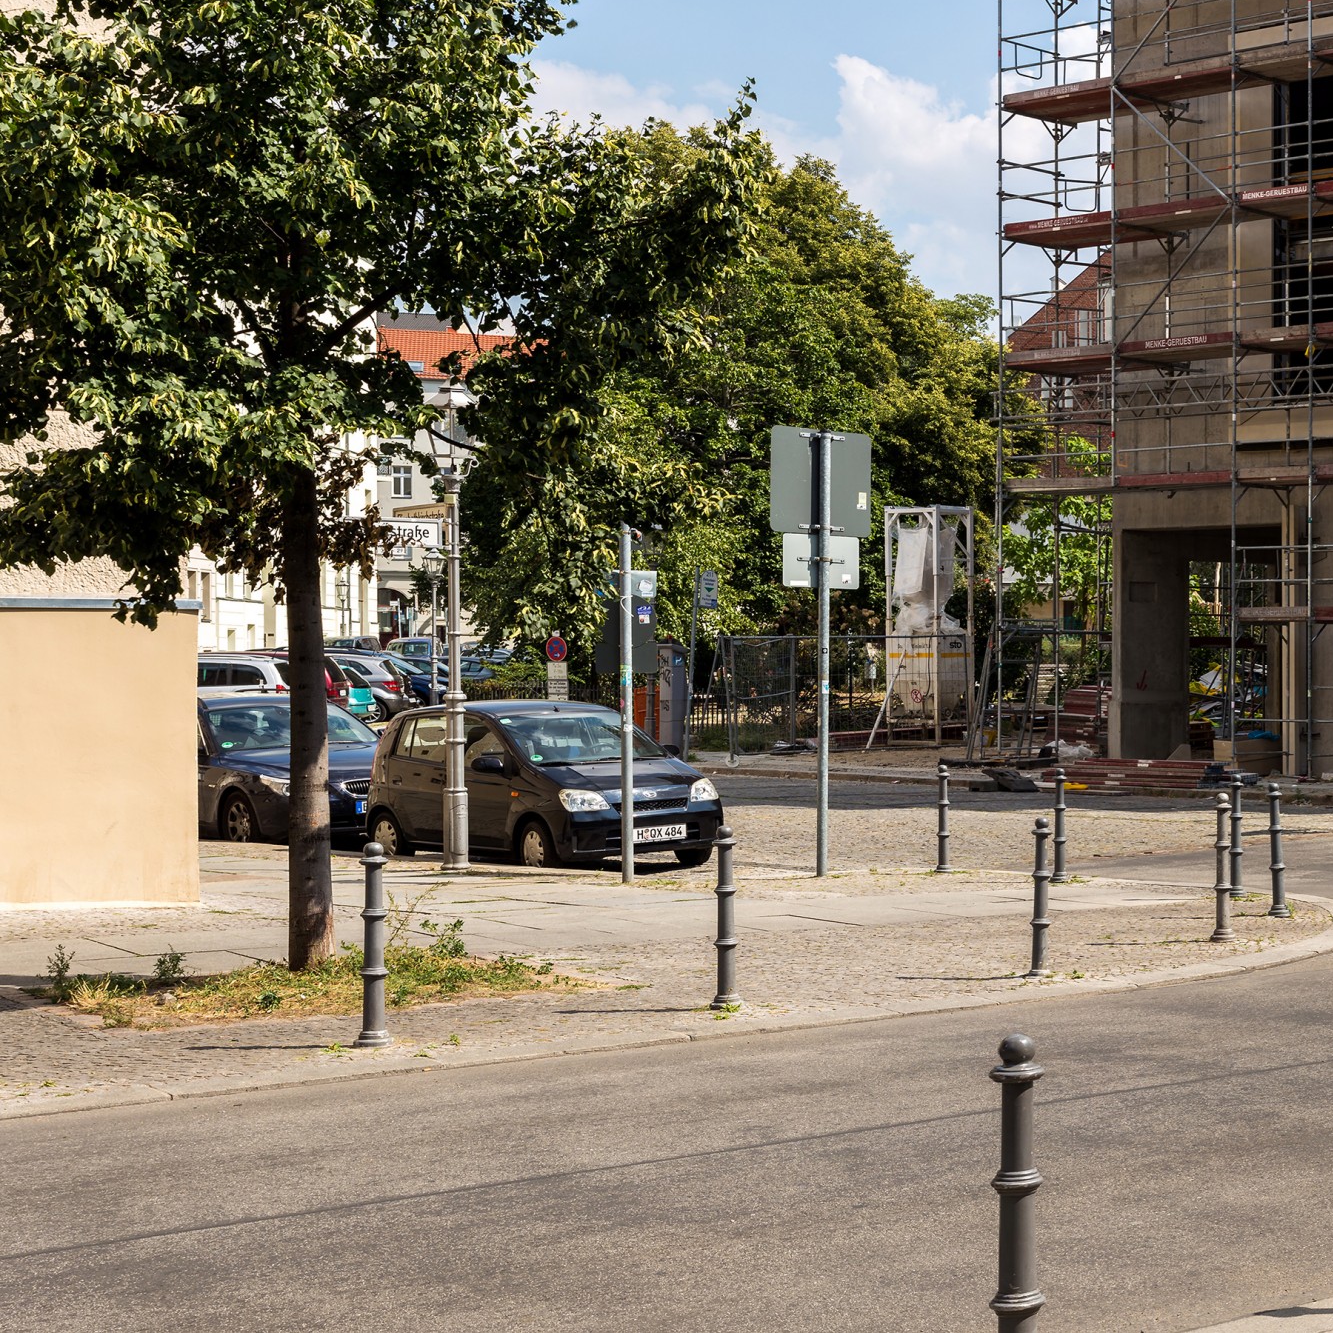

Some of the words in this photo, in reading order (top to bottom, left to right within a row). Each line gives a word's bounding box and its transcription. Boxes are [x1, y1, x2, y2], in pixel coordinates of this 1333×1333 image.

[1033, 84, 1079, 97] MENKE-GERUESTBAU
[1242, 185, 1307, 200] MENKE-GERUESTBAU
[1145, 336, 1207, 348] MENKE-GERUESTBAU
[949, 640, 963, 649] sto
[637, 829, 644, 840] H
[649, 827, 663, 839] QX
[664, 826, 683, 837] 484
